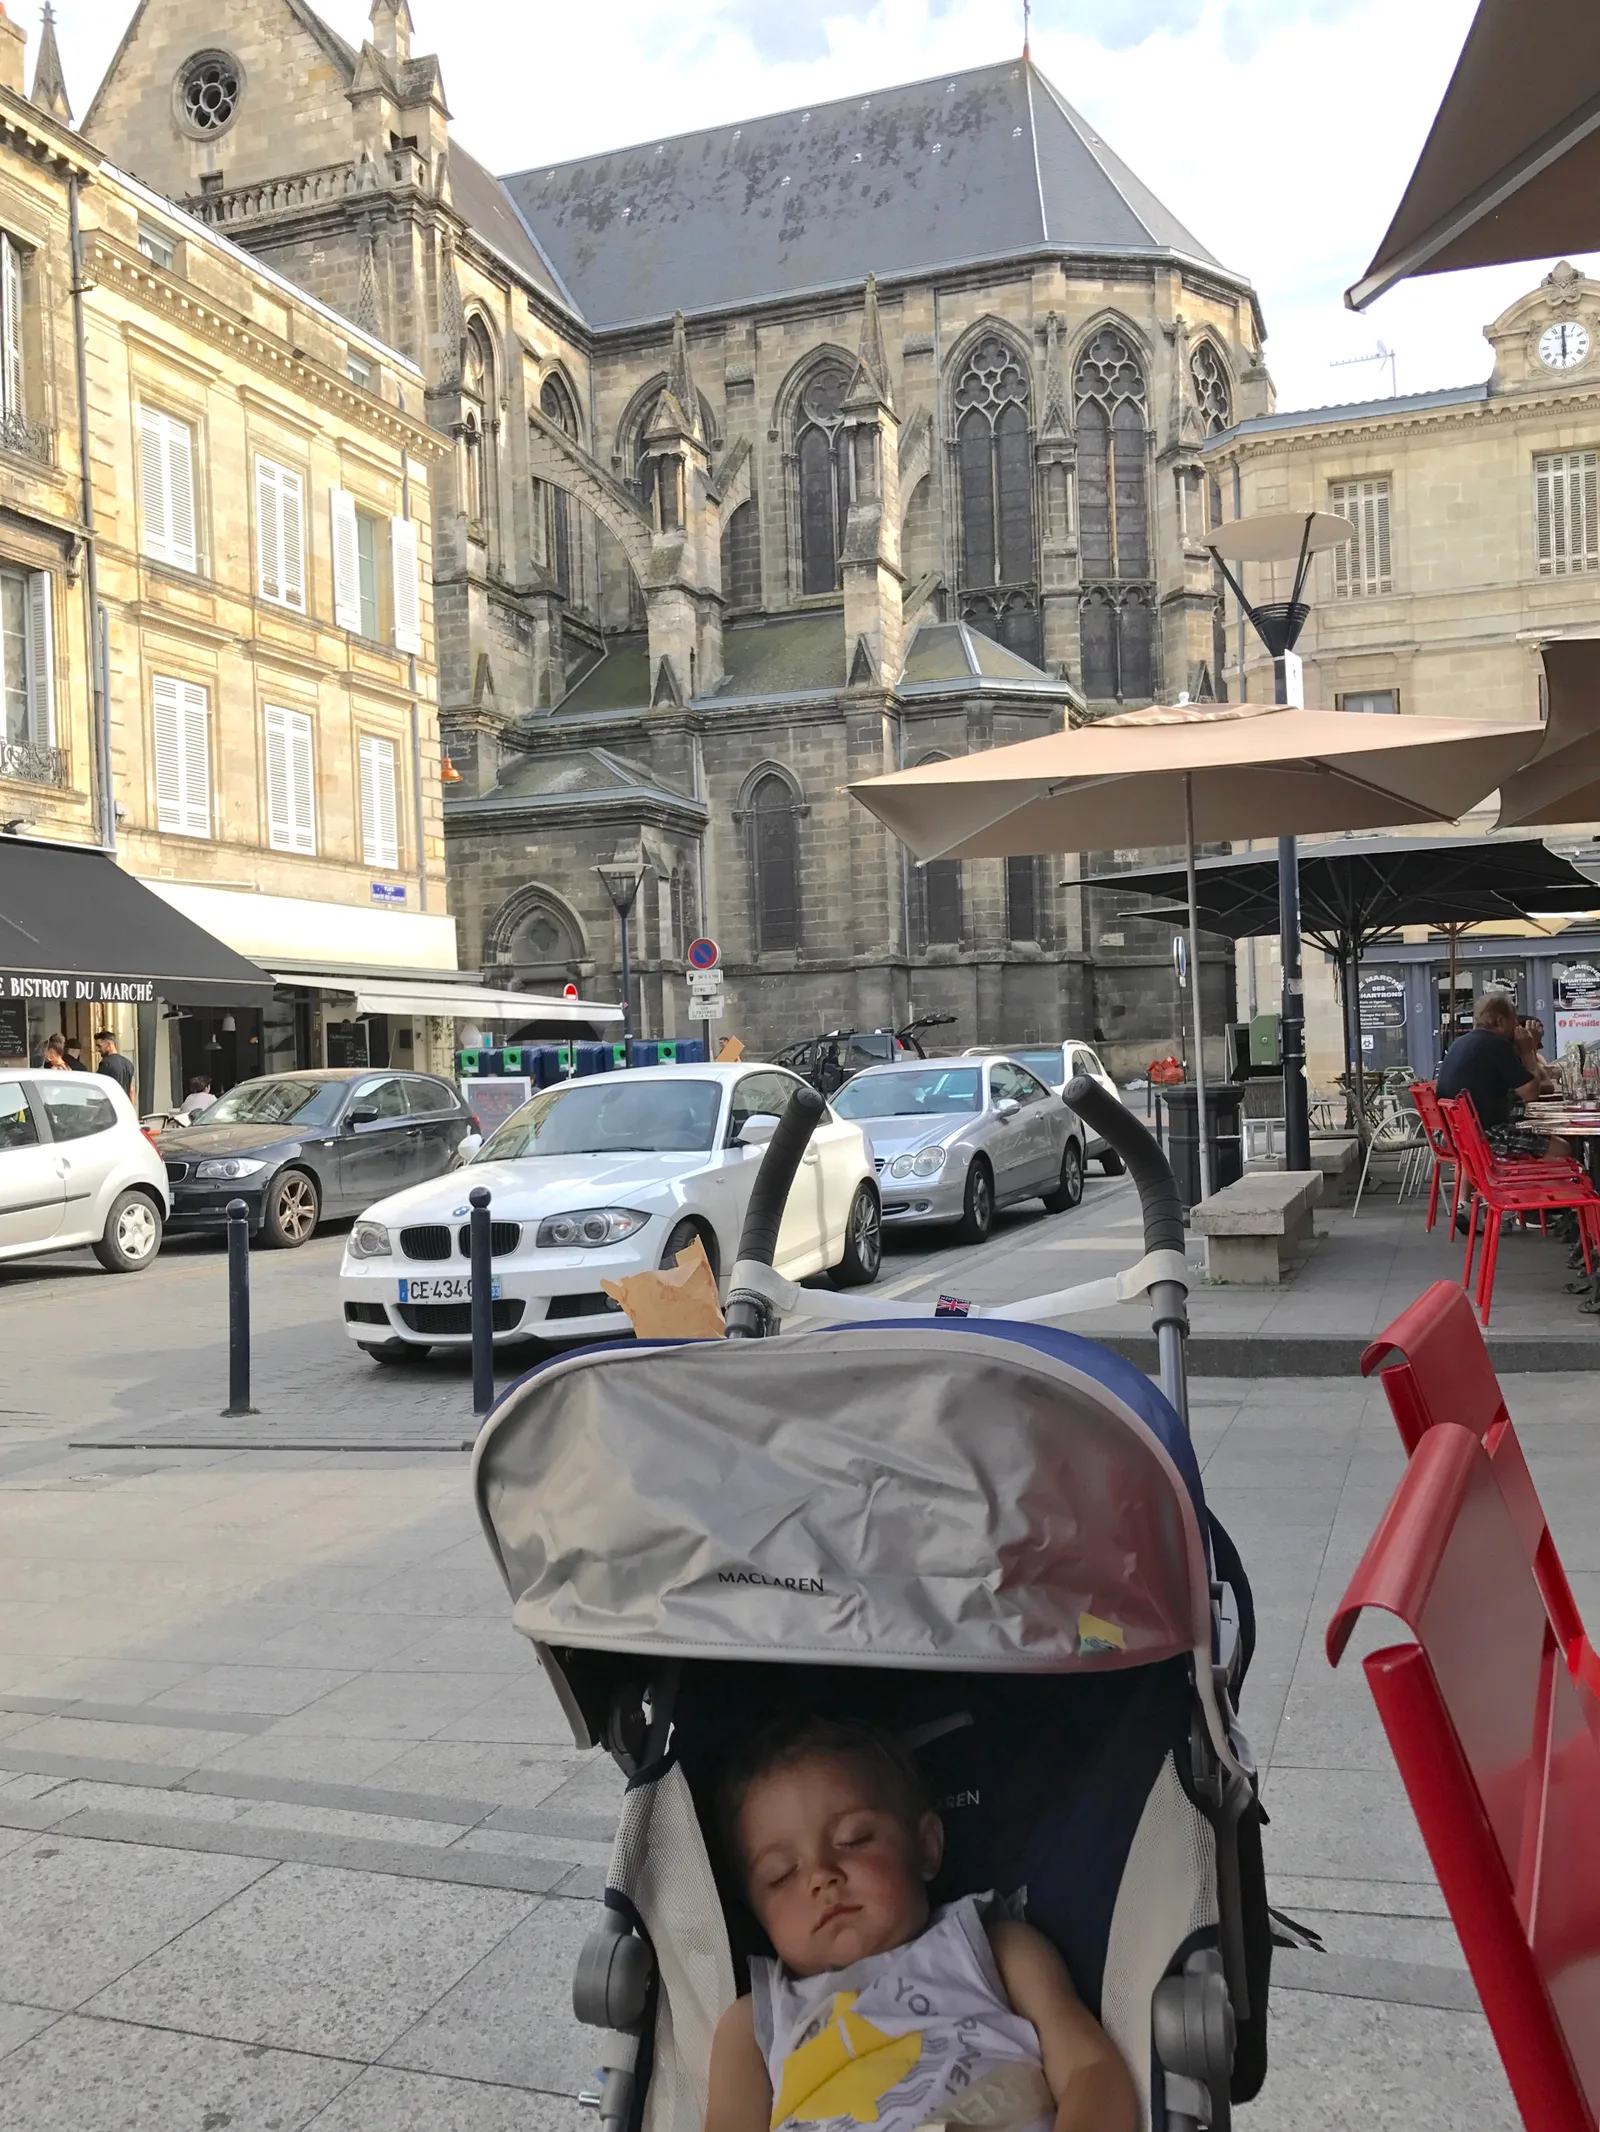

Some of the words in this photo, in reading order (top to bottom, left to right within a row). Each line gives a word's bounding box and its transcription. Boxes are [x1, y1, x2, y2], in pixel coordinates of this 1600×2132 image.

[11, 977, 69, 999] BISTROT
[76, 981, 94, 1000] DU
[100, 980, 153, 1001] MARCHÉ
[1359, 991, 1403, 999] HARTRONS
[717, 1572, 824, 1592] MACLAREN
